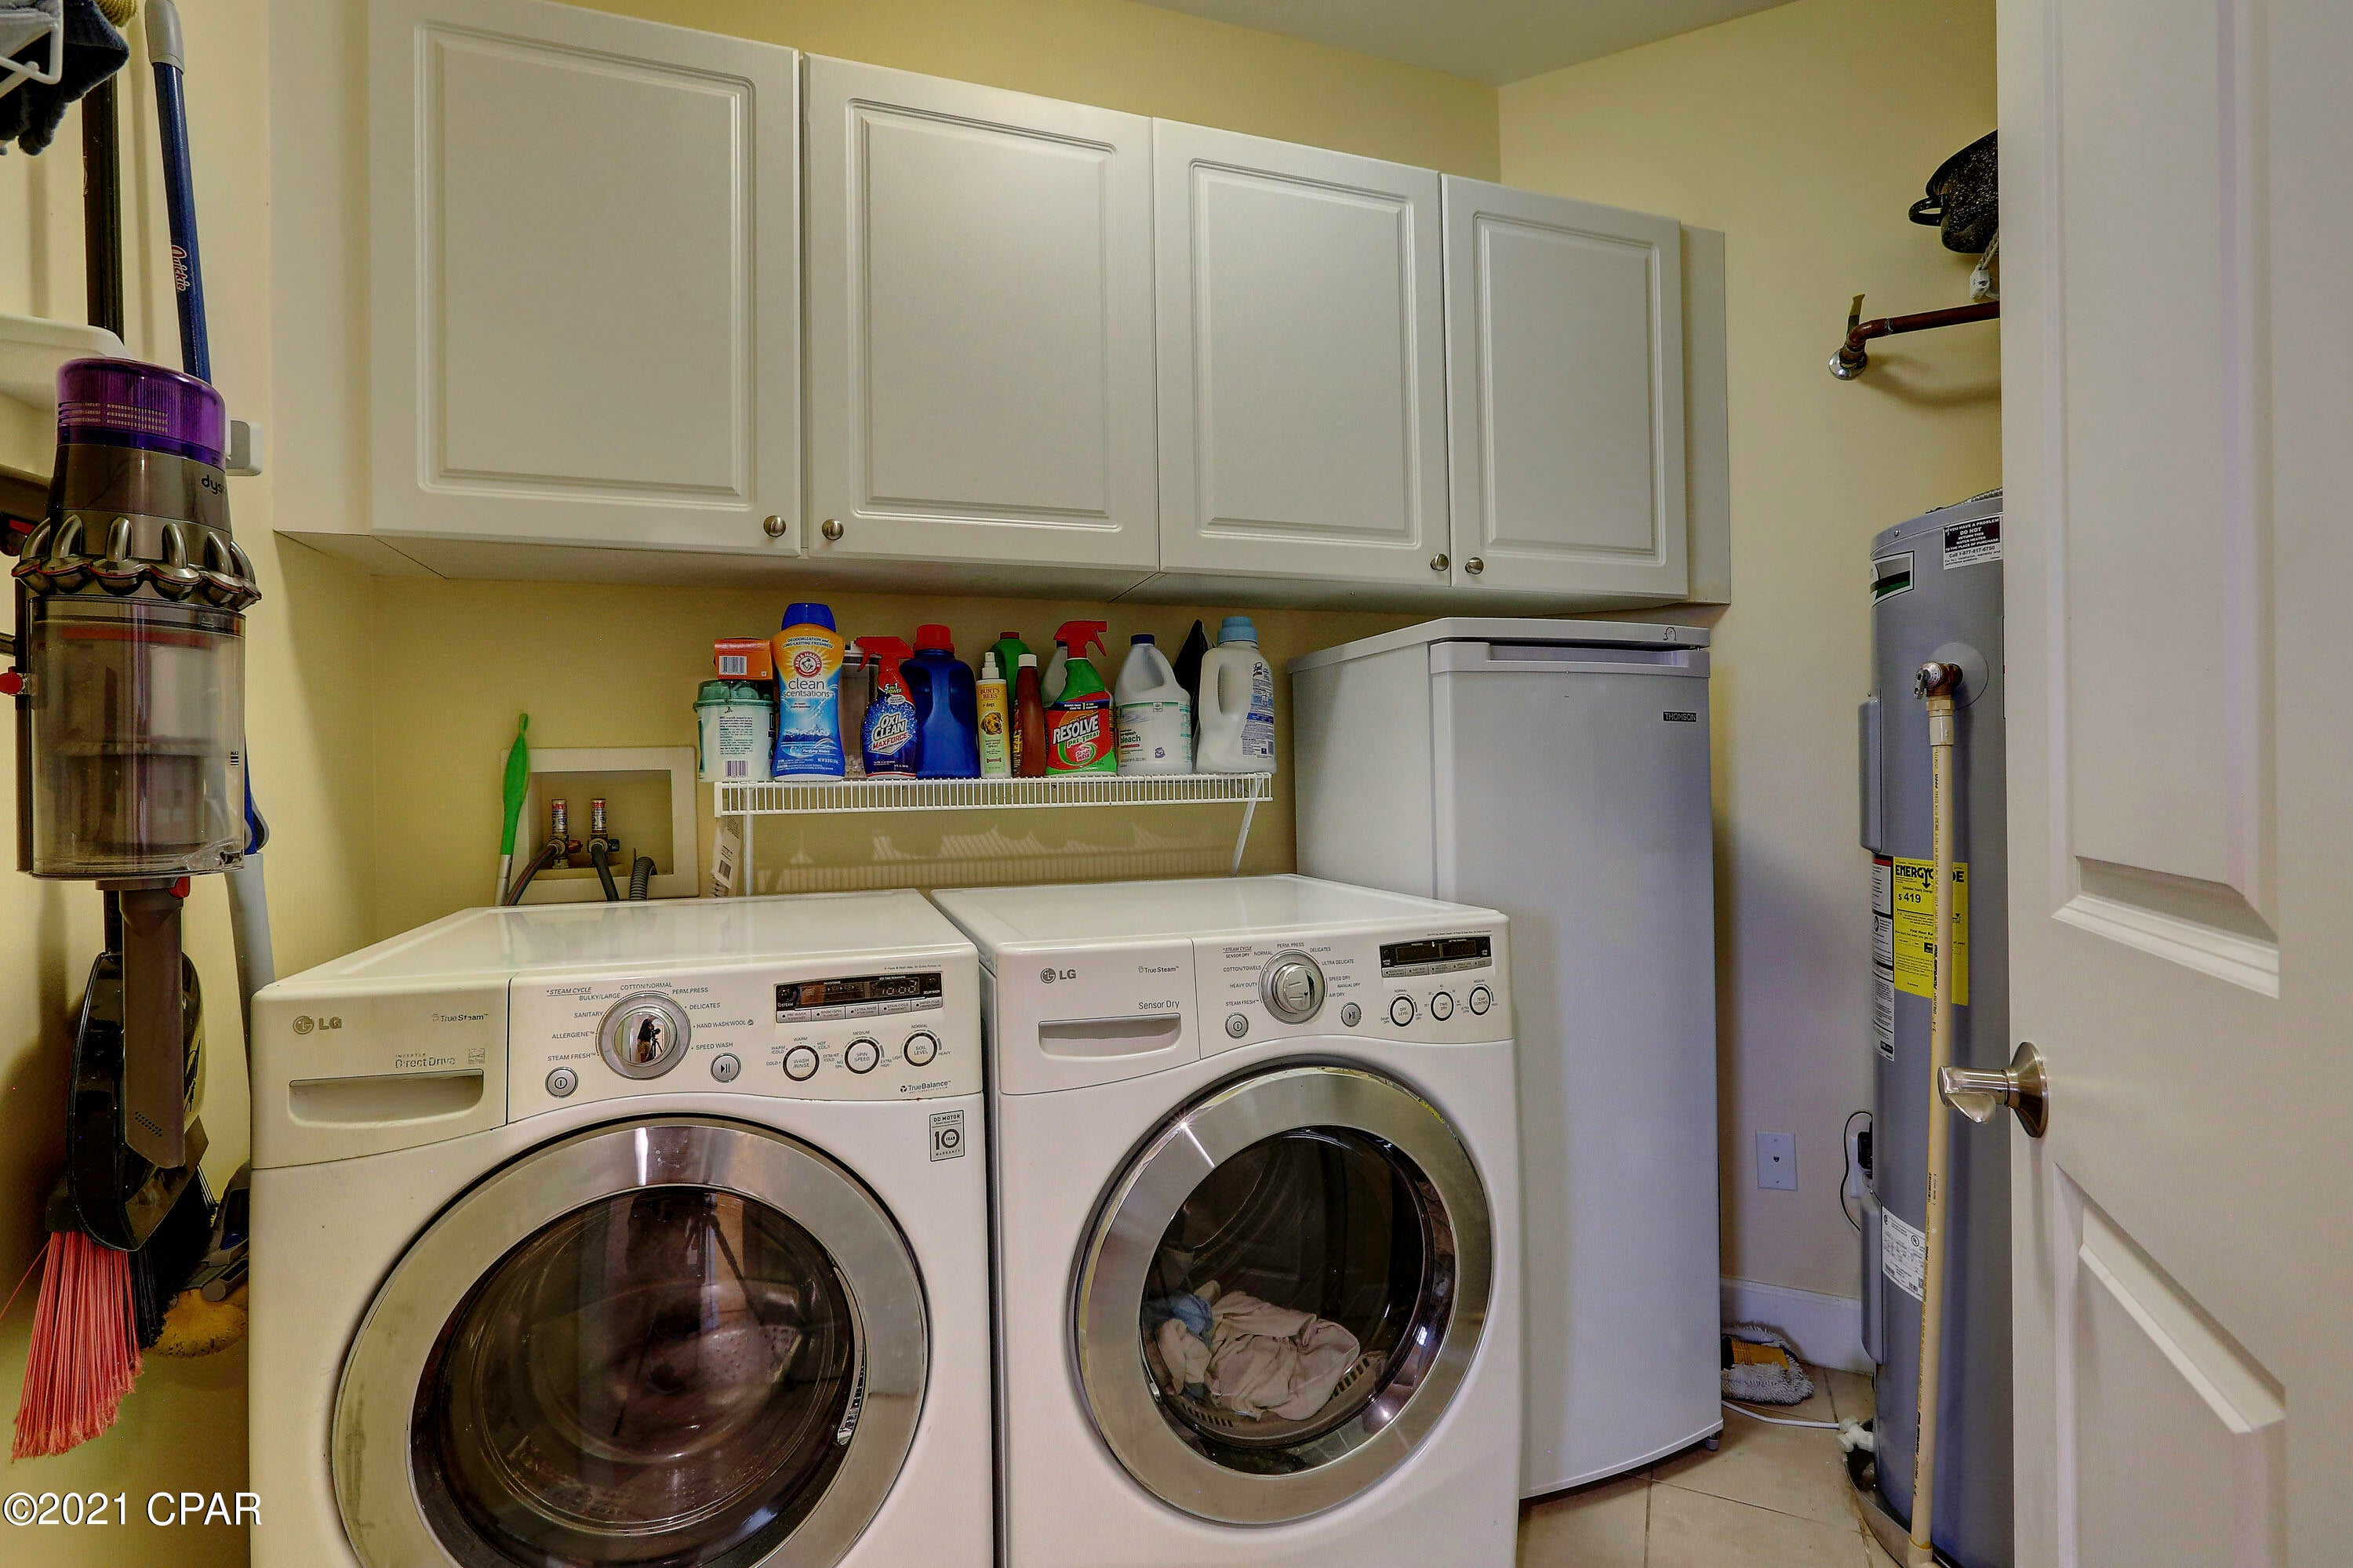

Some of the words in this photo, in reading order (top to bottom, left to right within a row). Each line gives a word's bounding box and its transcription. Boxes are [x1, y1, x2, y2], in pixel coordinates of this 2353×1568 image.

[1977, 518, 1999, 526] PROBLEM
[788, 678, 824, 689] clean
[1664, 712, 1696, 721] THOMSON
[873, 722, 907, 741] CLEAN
[1053, 715, 1099, 744] RESOLVE
[1067, 731, 1100, 748] PRE-TREAT
[1904, 893, 1922, 903] 419
[1059, 969, 1077, 980] LG
[620, 982, 672, 991] COTTON/NORMAL
[579, 992, 621, 1001] BULKY/LARGE
[1166, 1000, 1180, 1010] Dry
[318, 1017, 342, 1030] LG
[395, 1058, 427, 1068] Direct
[428, 1057, 456, 1067] Drive
[934, 1128, 960, 1151] 10
